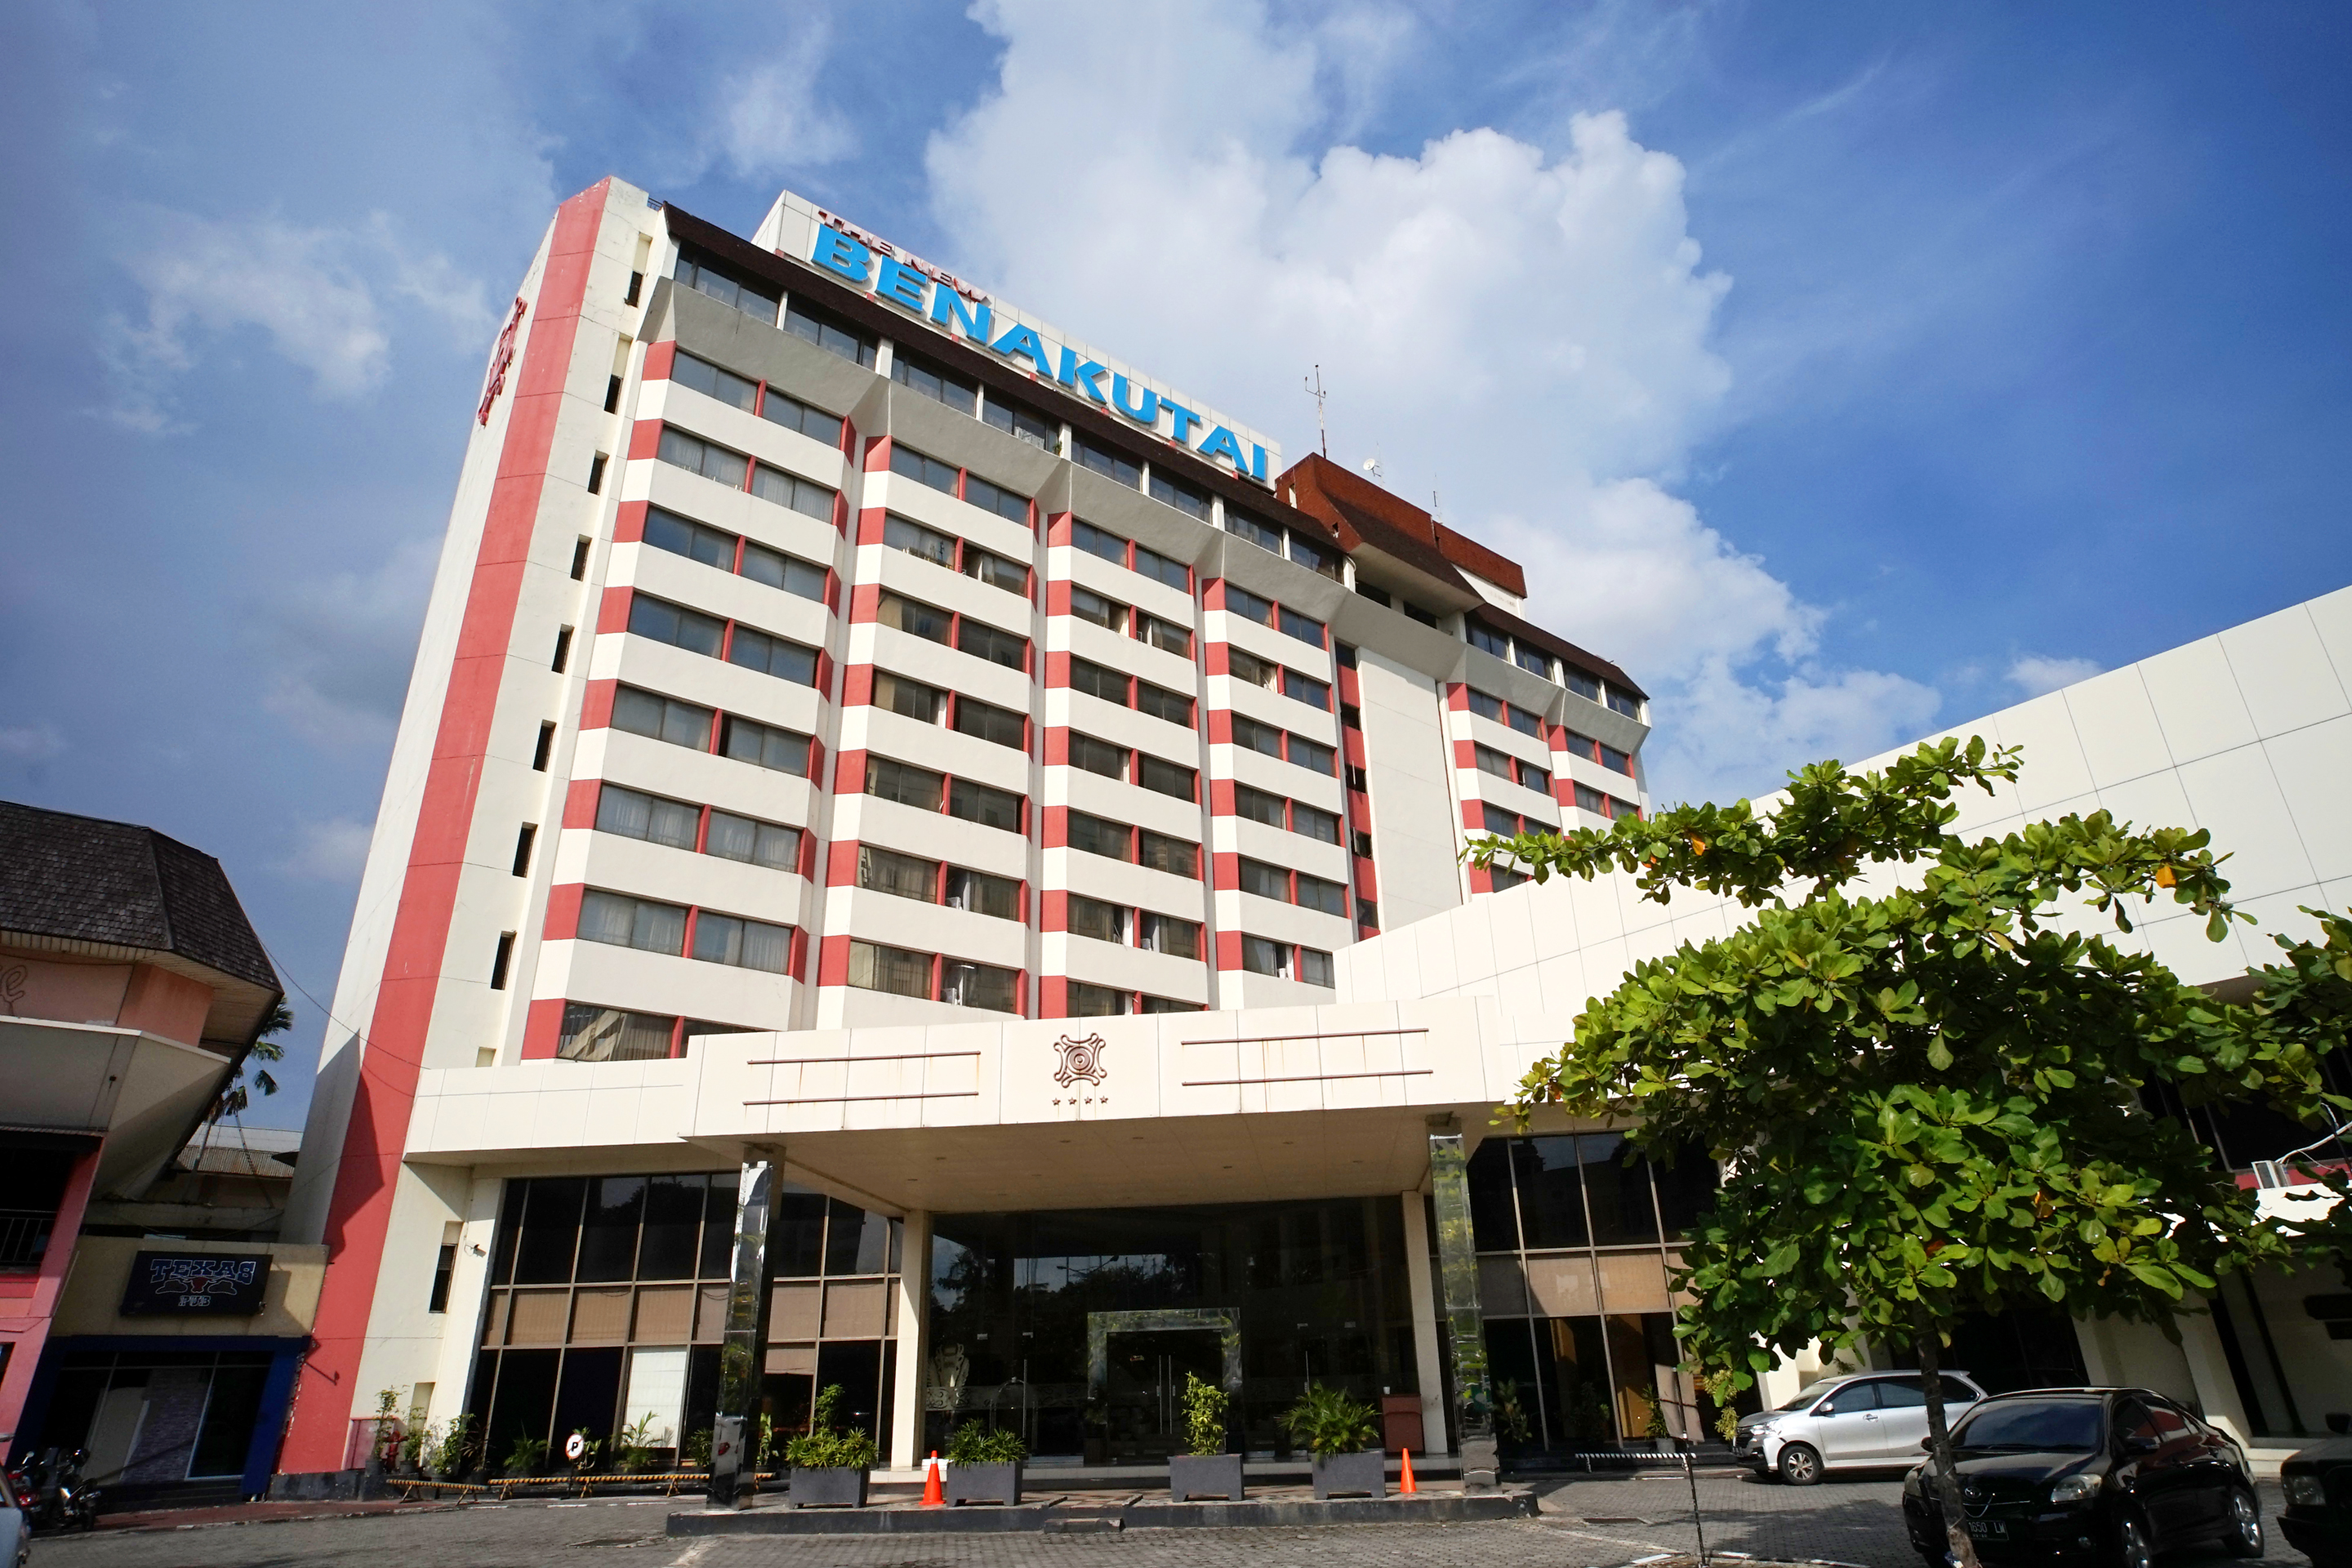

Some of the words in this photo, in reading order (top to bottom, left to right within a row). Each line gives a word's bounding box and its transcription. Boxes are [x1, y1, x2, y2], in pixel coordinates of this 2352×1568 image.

[818, 209, 894, 258] THE
[902, 252, 988, 303] NEW
[811, 223, 1267, 483] BENAKUTAI
[150, 1258, 256, 1285] TEXAS
[178, 1295, 212, 1307] PUB
[1968, 1521, 1988, 1533] 1650
